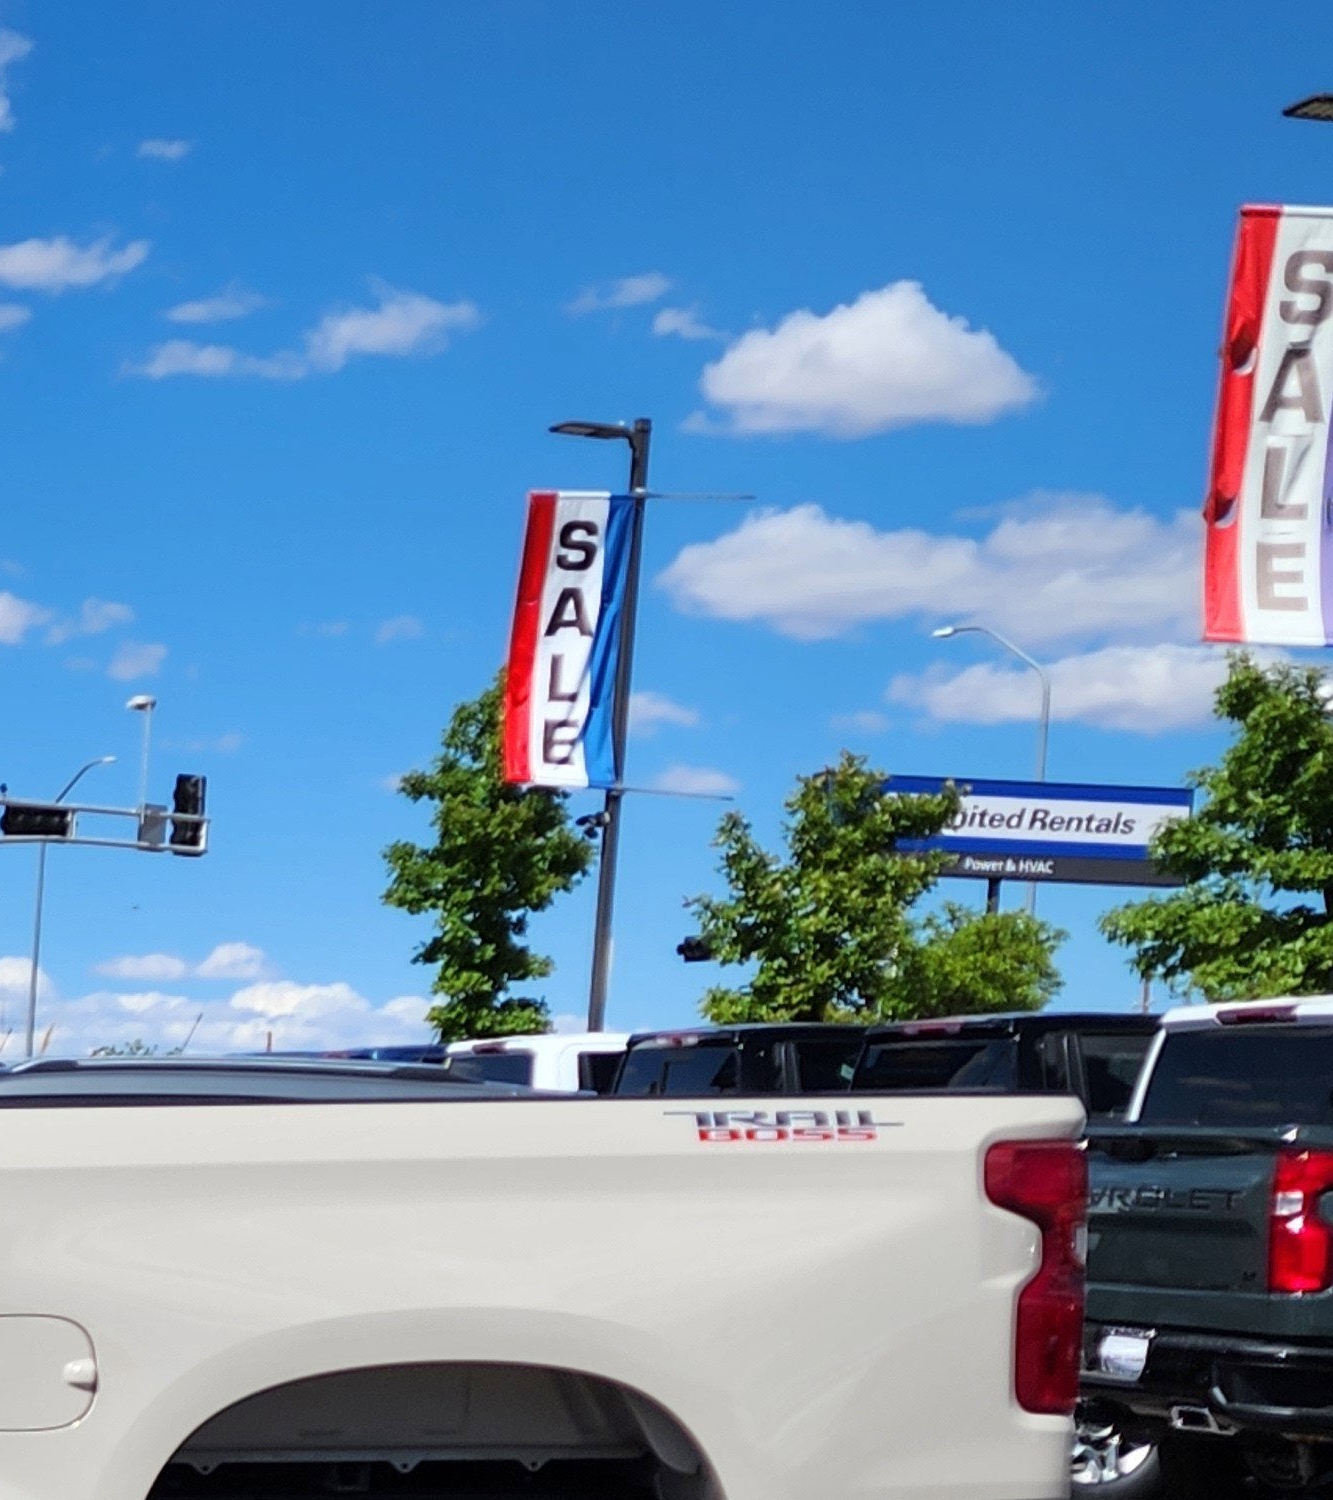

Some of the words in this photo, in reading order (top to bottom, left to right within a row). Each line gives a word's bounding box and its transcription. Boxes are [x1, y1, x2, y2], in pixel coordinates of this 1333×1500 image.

[1255, 250, 1333, 611] SALE
[541, 519, 599, 765] SALE
[944, 804, 1027, 831] nited
[1028, 807, 1137, 836] Rentals
[1018, 858, 1055, 875] HVAC
[663, 1110, 904, 1127] TRAIL
[697, 1127, 877, 1142] BOSS
[1088, 1185, 1245, 1212] VROLET
